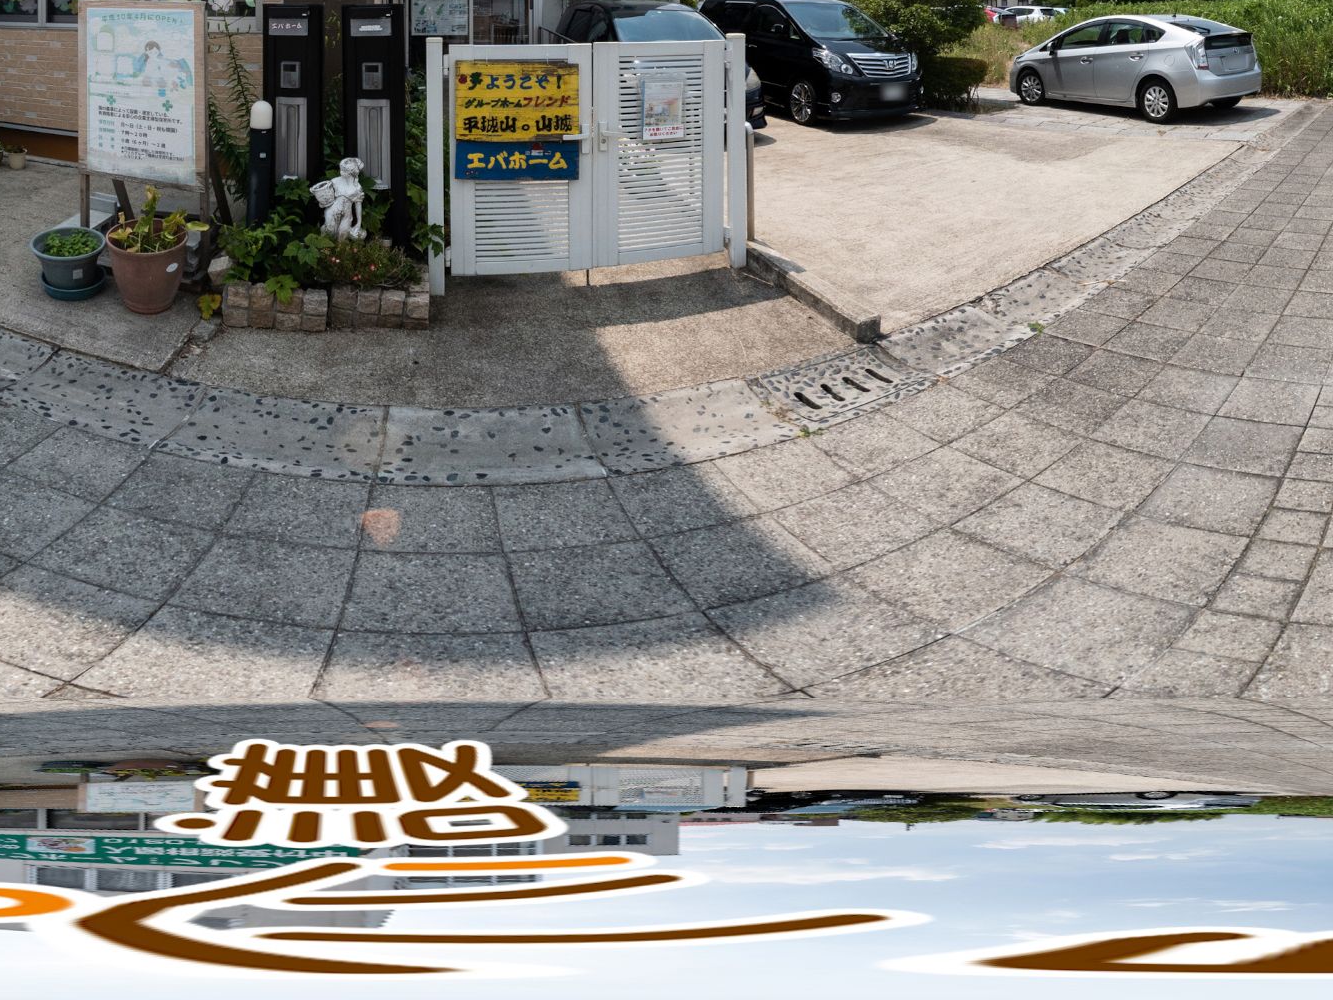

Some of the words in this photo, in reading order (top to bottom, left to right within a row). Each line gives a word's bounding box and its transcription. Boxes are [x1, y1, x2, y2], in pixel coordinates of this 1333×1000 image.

[467, 151, 568, 170] エバホーム
